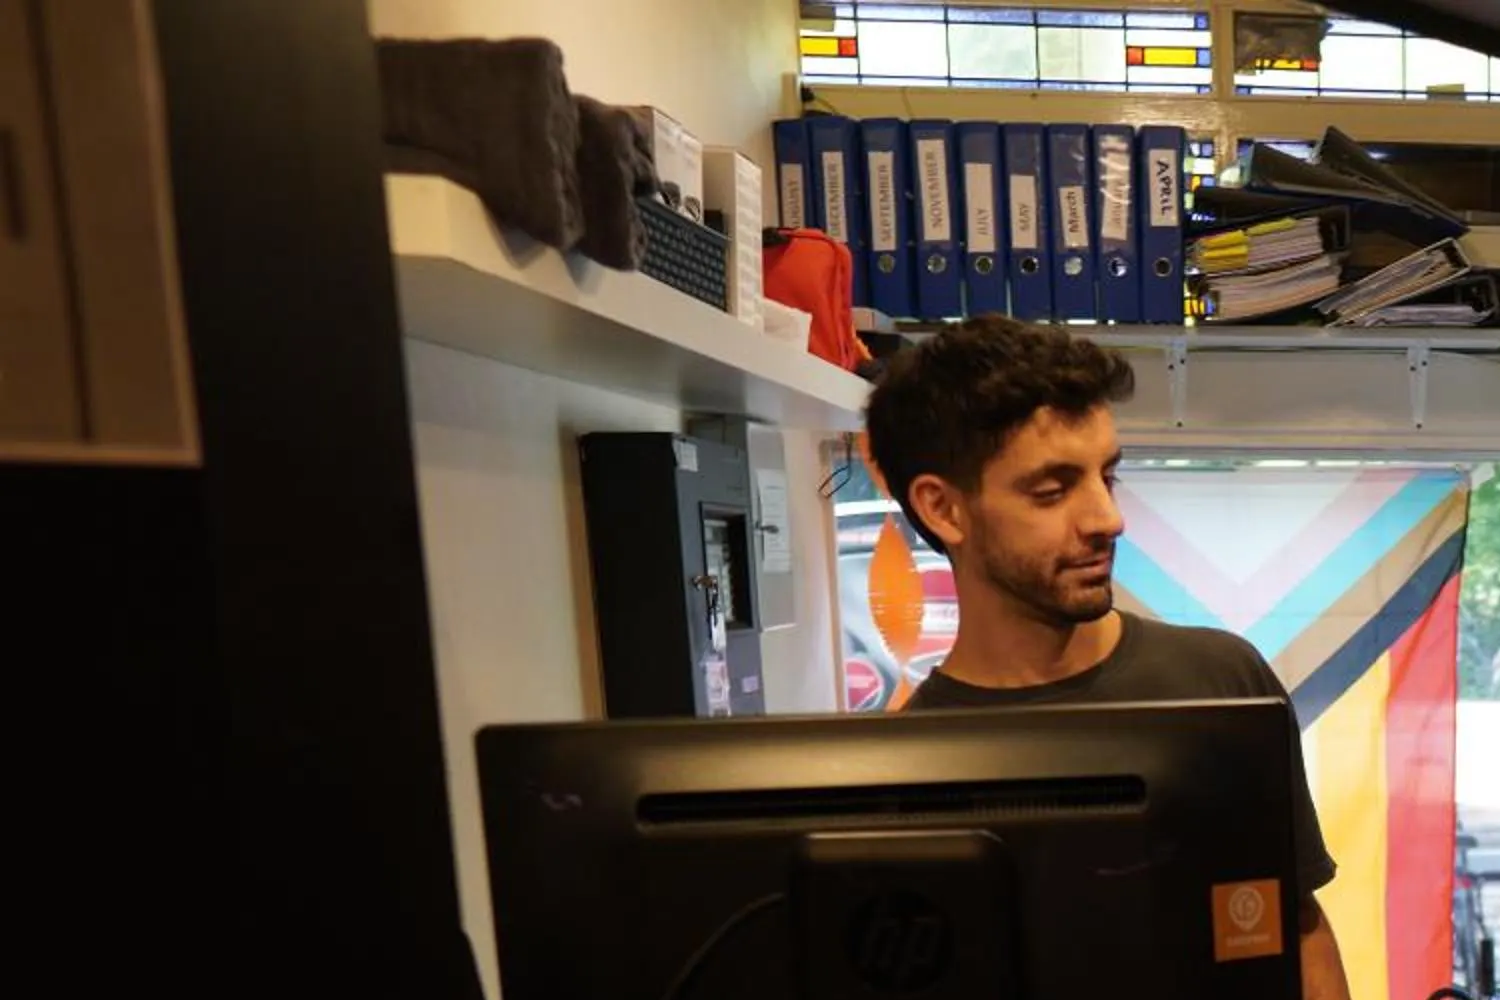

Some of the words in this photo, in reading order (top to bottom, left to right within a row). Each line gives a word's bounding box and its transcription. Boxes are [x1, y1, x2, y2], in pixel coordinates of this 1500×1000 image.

[877, 164, 892, 242] SEPTEMBER
[925, 151, 943, 229] NOVEMBER
[1063, 191, 1079, 233] March
[1155, 160, 1174, 216] APRIL
[862, 895, 941, 990] hp
